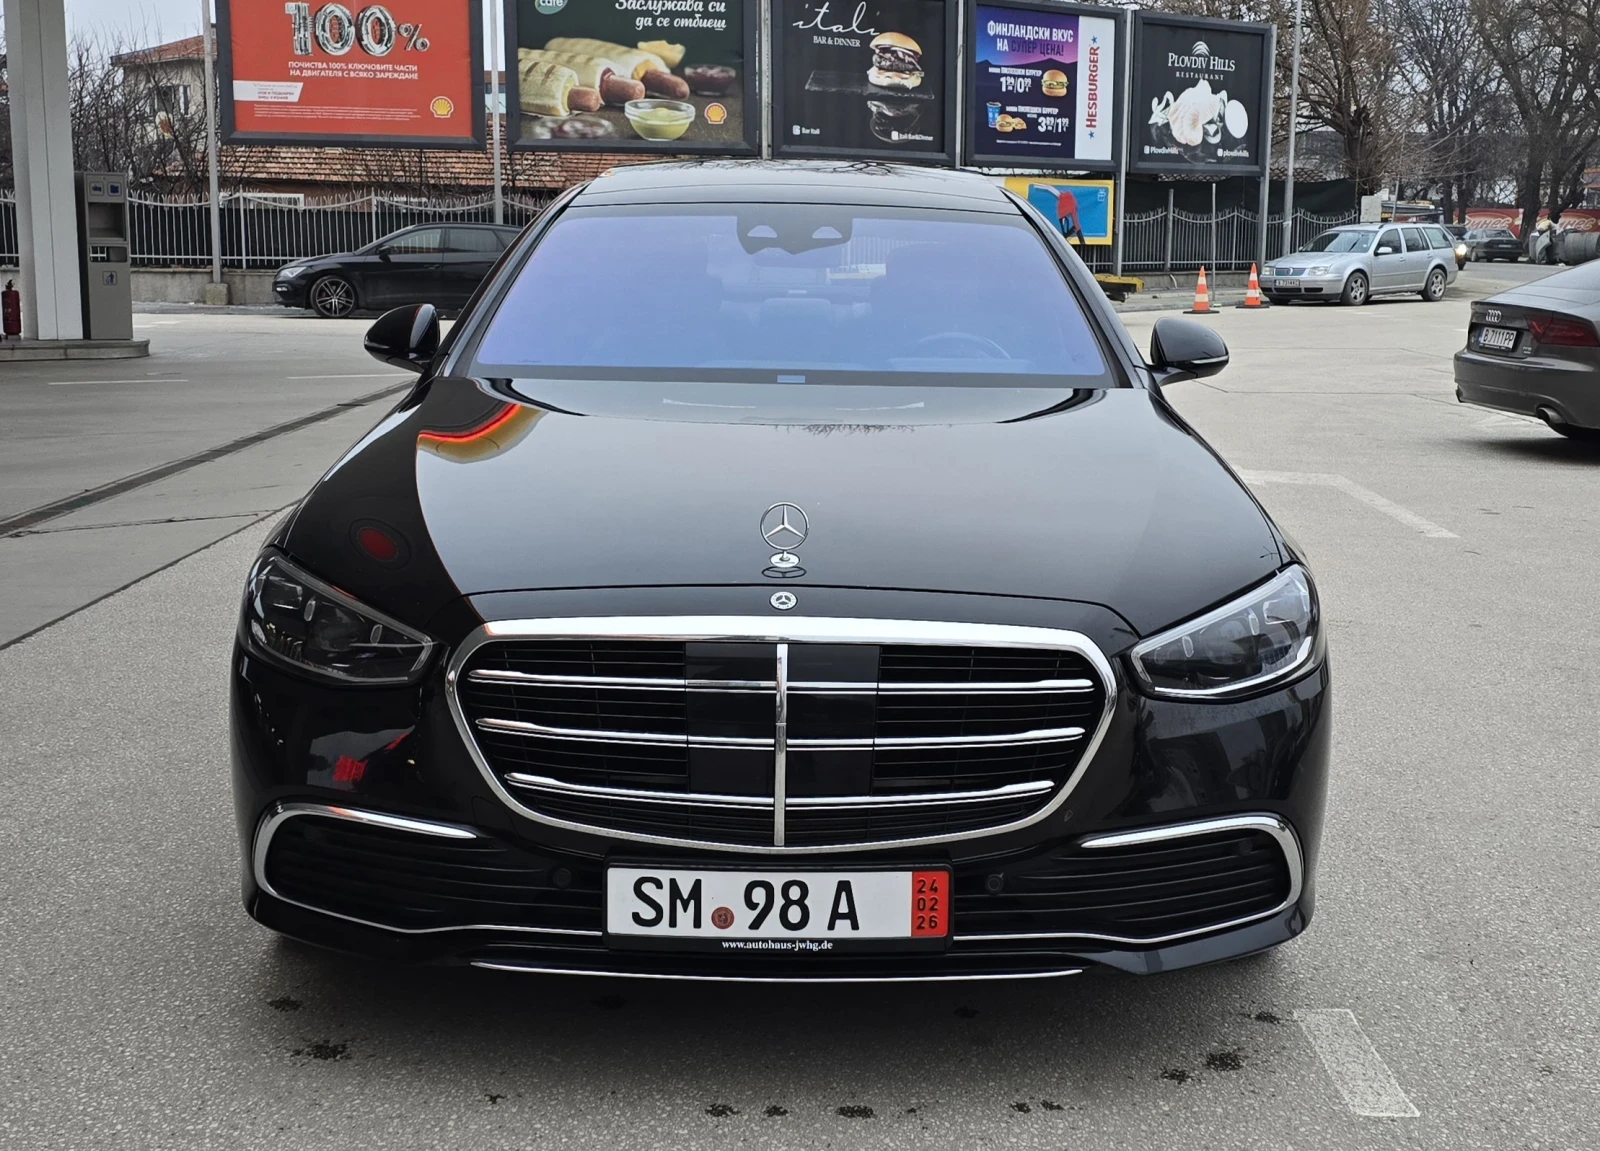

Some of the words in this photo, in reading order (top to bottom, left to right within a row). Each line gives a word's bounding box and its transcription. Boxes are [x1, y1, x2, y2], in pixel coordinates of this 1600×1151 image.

[708, 1, 726, 13] си
[635, 16, 653, 31] да
[656, 16, 670, 27] се
[673, 14, 727, 31] отбиеш
[987, 20, 1050, 41] ФИНЛАНДСКИ
[1052, 28, 1074, 43] ВКУС
[813, 35, 827, 45] BAR
[827, 37, 833, 45] &
[834, 37, 861, 48] DINNER
[996, 38, 1009, 52] НА
[1011, 40, 1037, 54] СУПЕР
[1040, 42, 1064, 57] ЦЕНА!
[288, 61, 328, 69] ПОЧИСТВА
[329, 62, 347, 70] 100%
[348, 63, 393, 71] КЛЮЧОВИТЕ
[394, 64, 418, 72] ЧАСТИ
[375, 72, 419, 80] ЗАРЕЖДАНЕ
[1176, 71, 1225, 81] RESTAURANT
[1085, 46, 1100, 128] HESBURGER
[916, 878, 939, 893] 24
[631, 876, 702, 929] SM
[743, 879, 811, 932] 98
[827, 880, 860, 931] A
[916, 898, 939, 912] 02
[916, 915, 938, 930] 26
[721, 938, 834, 952] www.autohaus-jwhg.de
